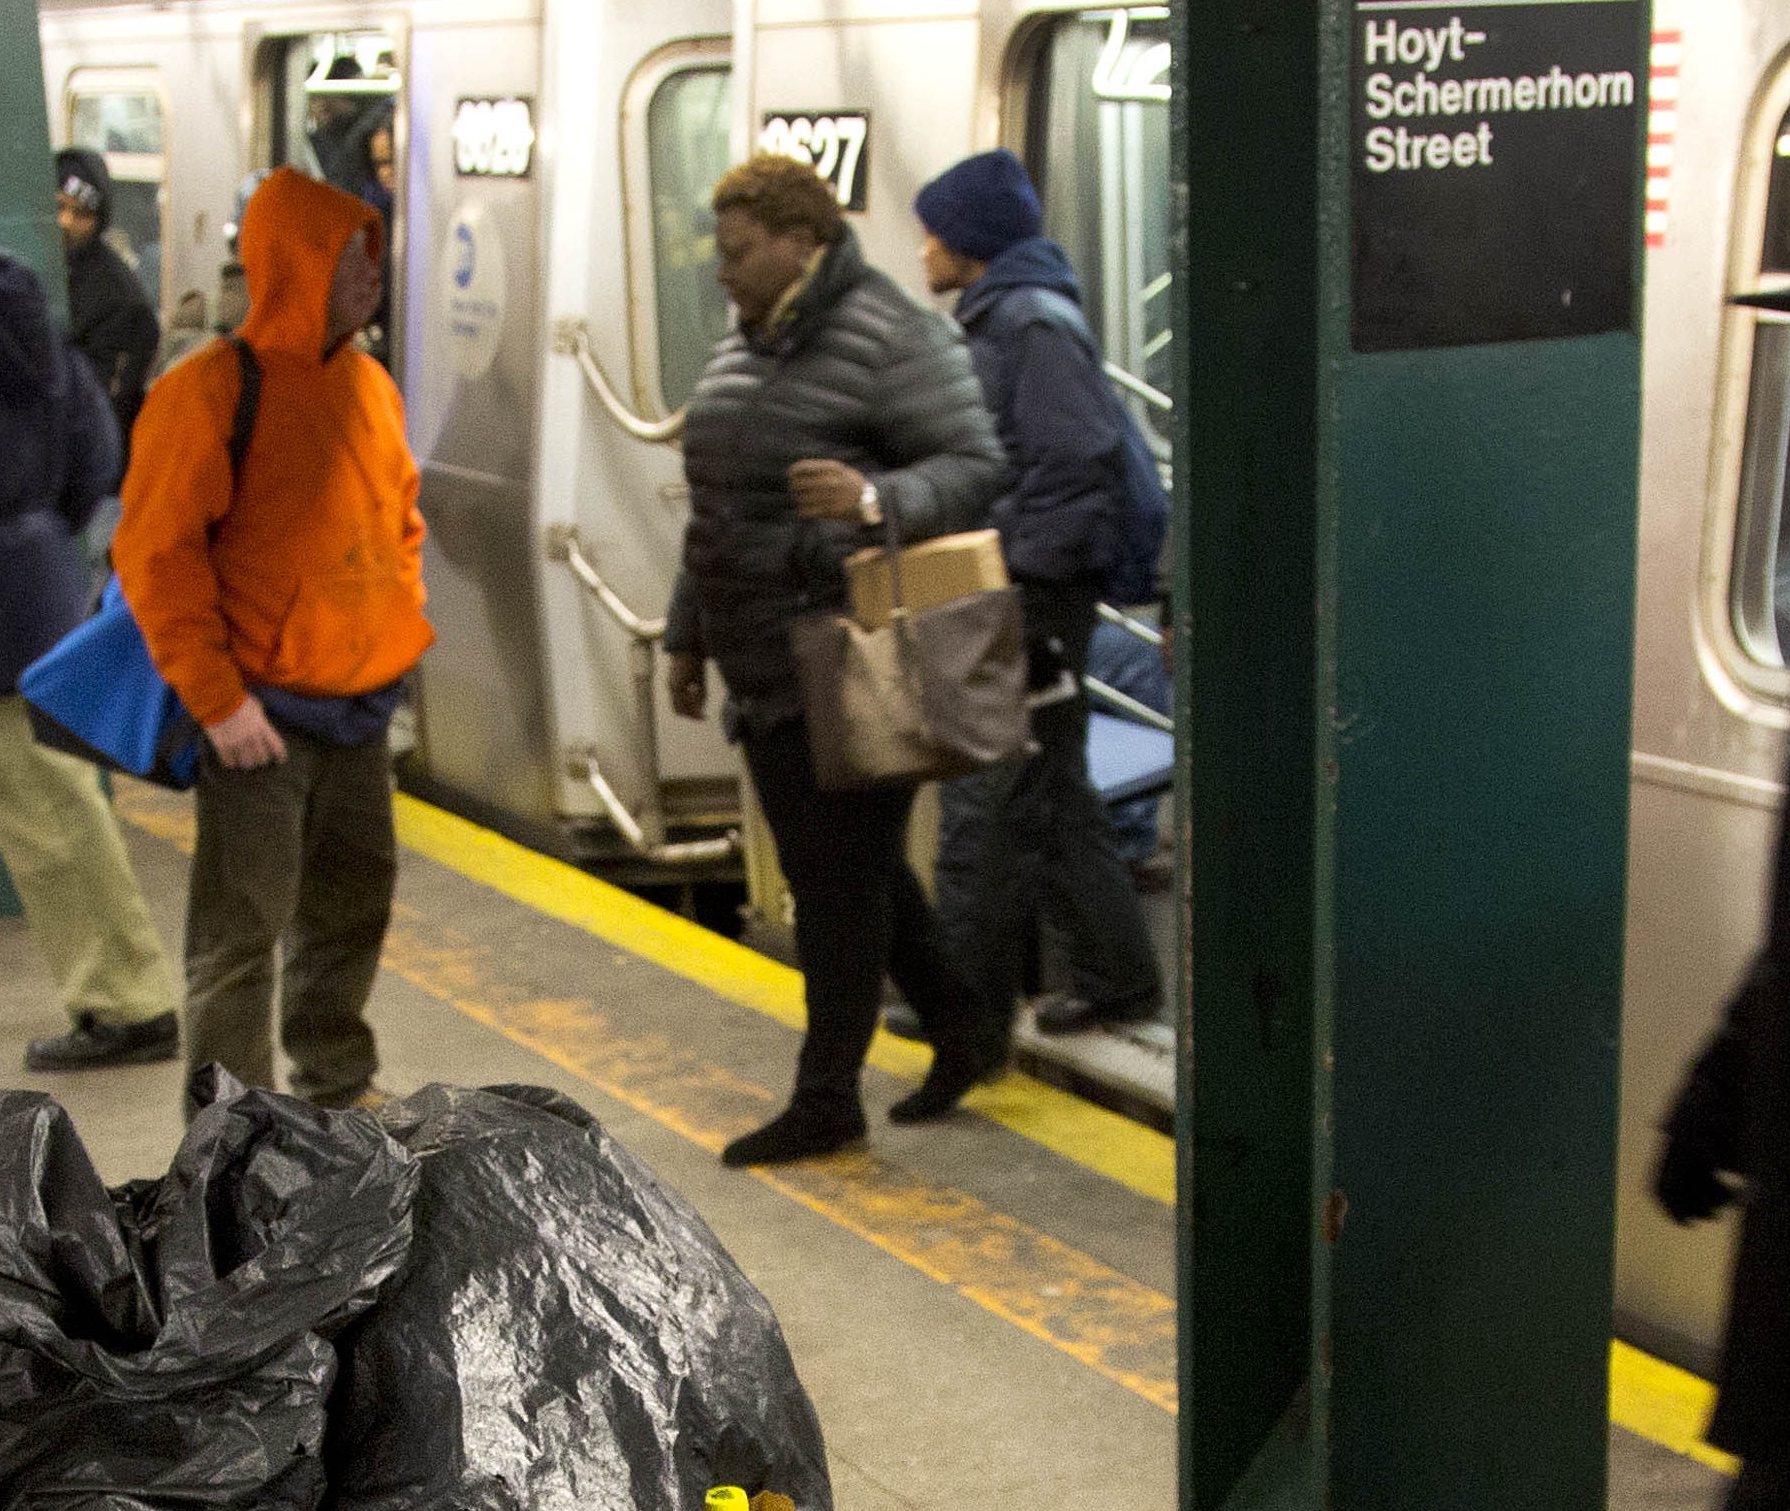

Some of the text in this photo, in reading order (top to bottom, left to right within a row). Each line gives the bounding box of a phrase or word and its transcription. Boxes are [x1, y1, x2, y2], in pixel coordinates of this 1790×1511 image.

[1364, 15, 1487, 72] Hoyt-
[1365, 64, 1634, 119] Schermerhorn
[1365, 121, 1494, 172] Street
